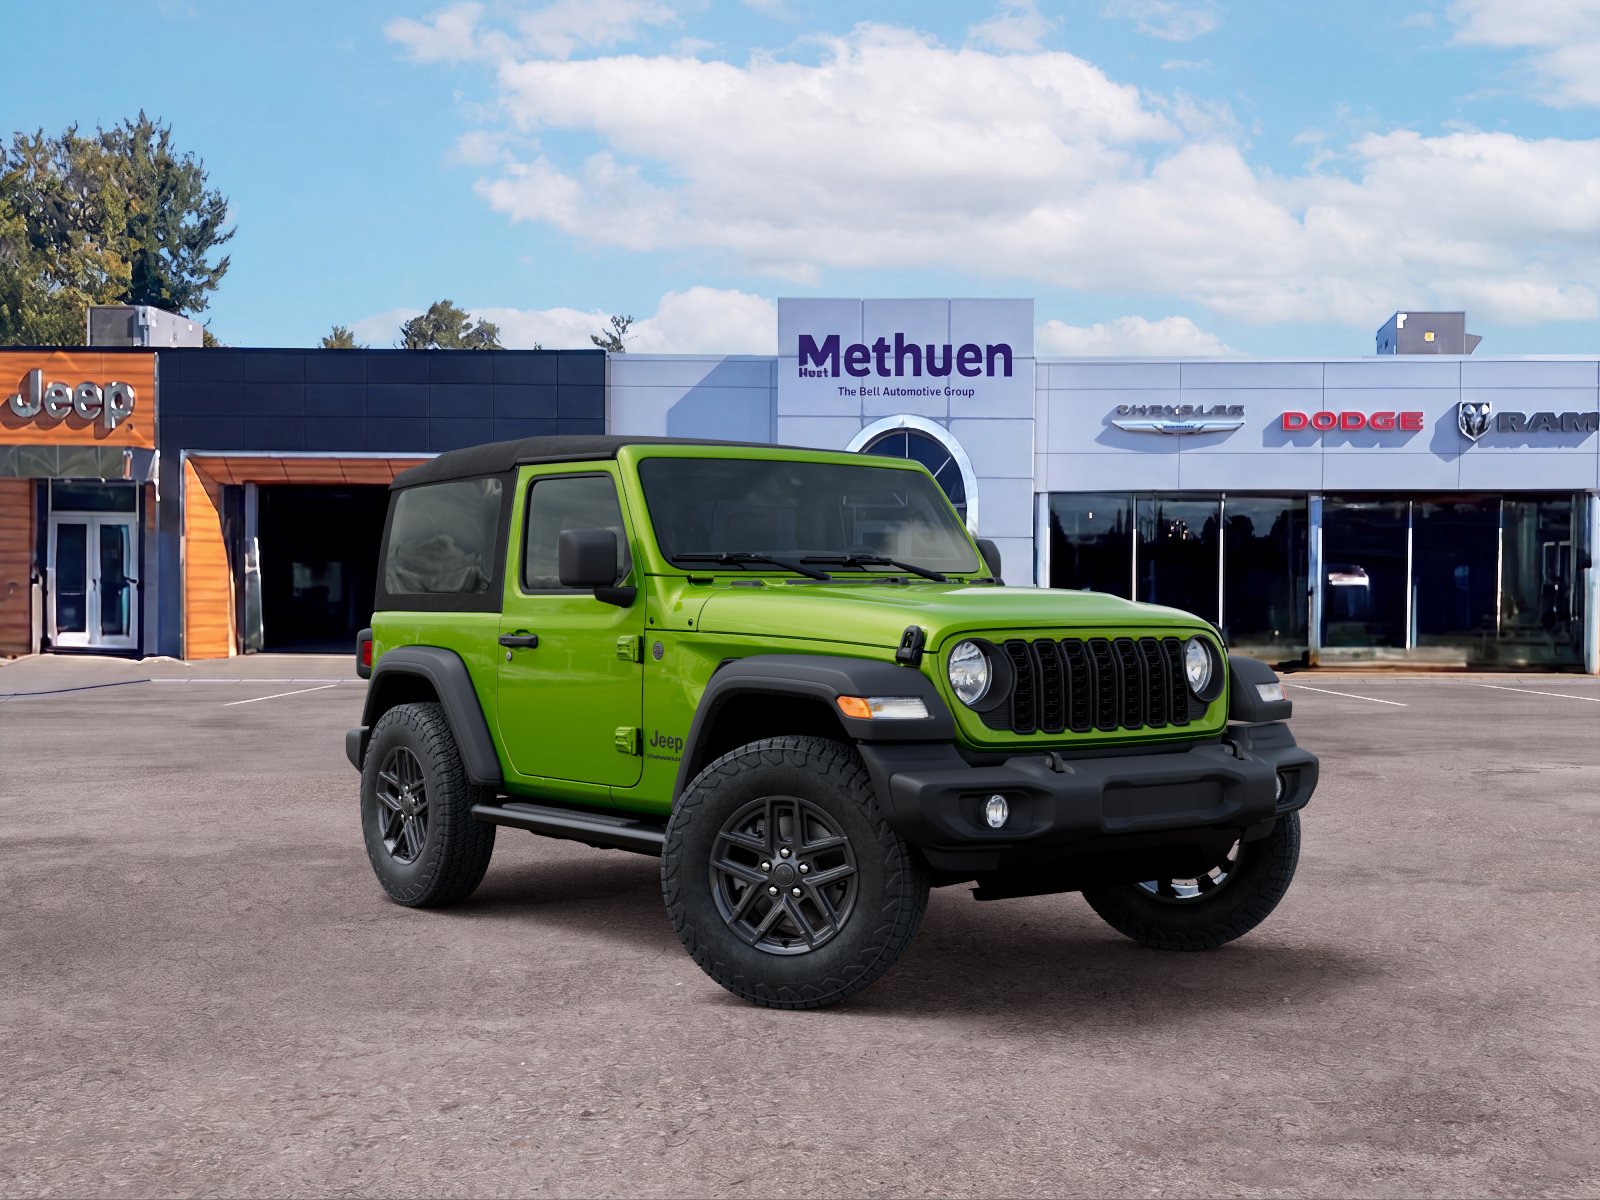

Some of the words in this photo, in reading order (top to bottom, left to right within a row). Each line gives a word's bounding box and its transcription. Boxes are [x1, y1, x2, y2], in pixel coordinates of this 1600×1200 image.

[798, 332, 1013, 378] Methuen
[8, 368, 135, 429] Jeep
[838, 386, 857, 397] The
[859, 386, 880, 397] Bell
[883, 386, 941, 397] Automotive
[944, 386, 975, 398] Group
[1282, 411, 1424, 431] DODGE
[1498, 411, 1599, 432] RAM
[649, 729, 684, 754] Jeep
